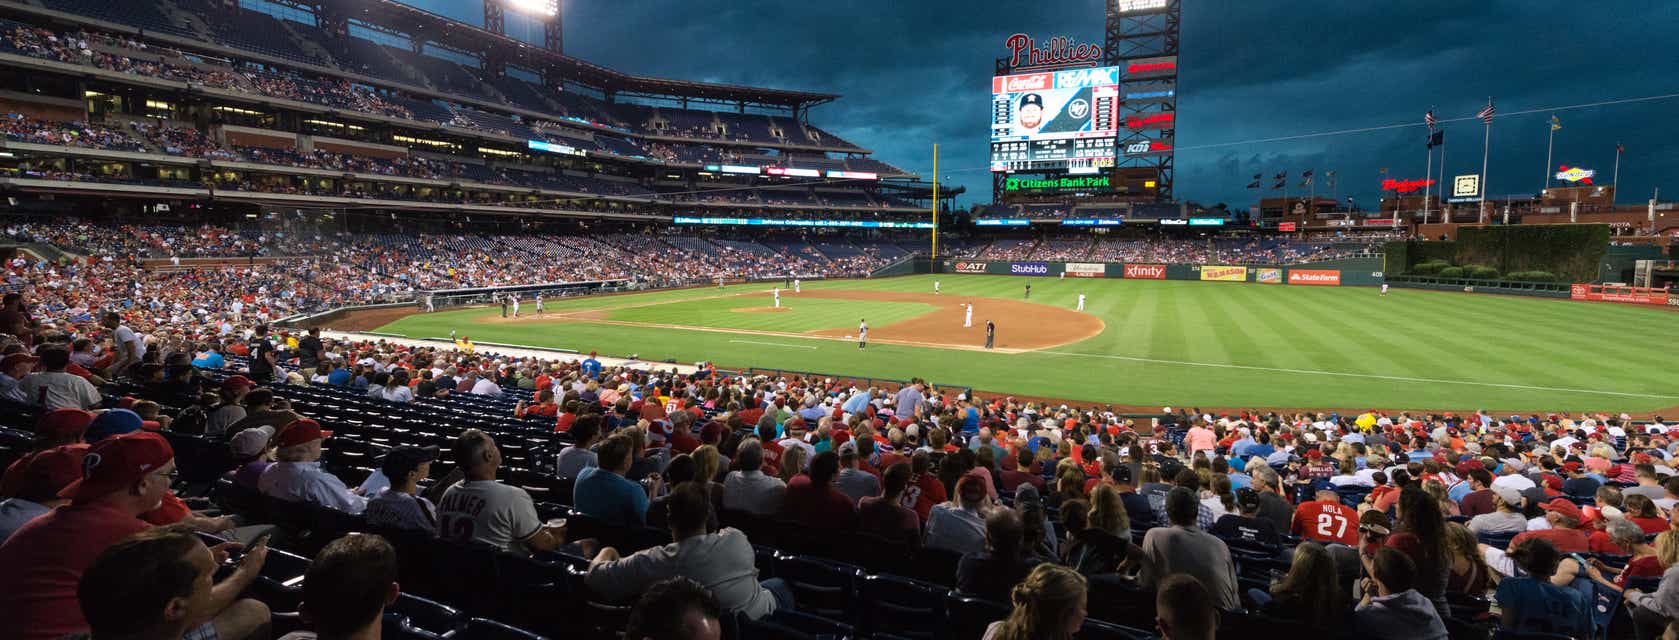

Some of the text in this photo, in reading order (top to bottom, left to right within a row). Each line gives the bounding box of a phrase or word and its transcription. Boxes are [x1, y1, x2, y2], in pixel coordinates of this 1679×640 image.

[1006, 33, 1102, 67] Phillies
[1020, 177, 1110, 188] Citizens Bank Park
[1011, 264, 1047, 273] StubHub
[1127, 265, 1163, 278] xfinity
[1322, 504, 1342, 515] NOLA
[1318, 513, 1347, 538] 27
